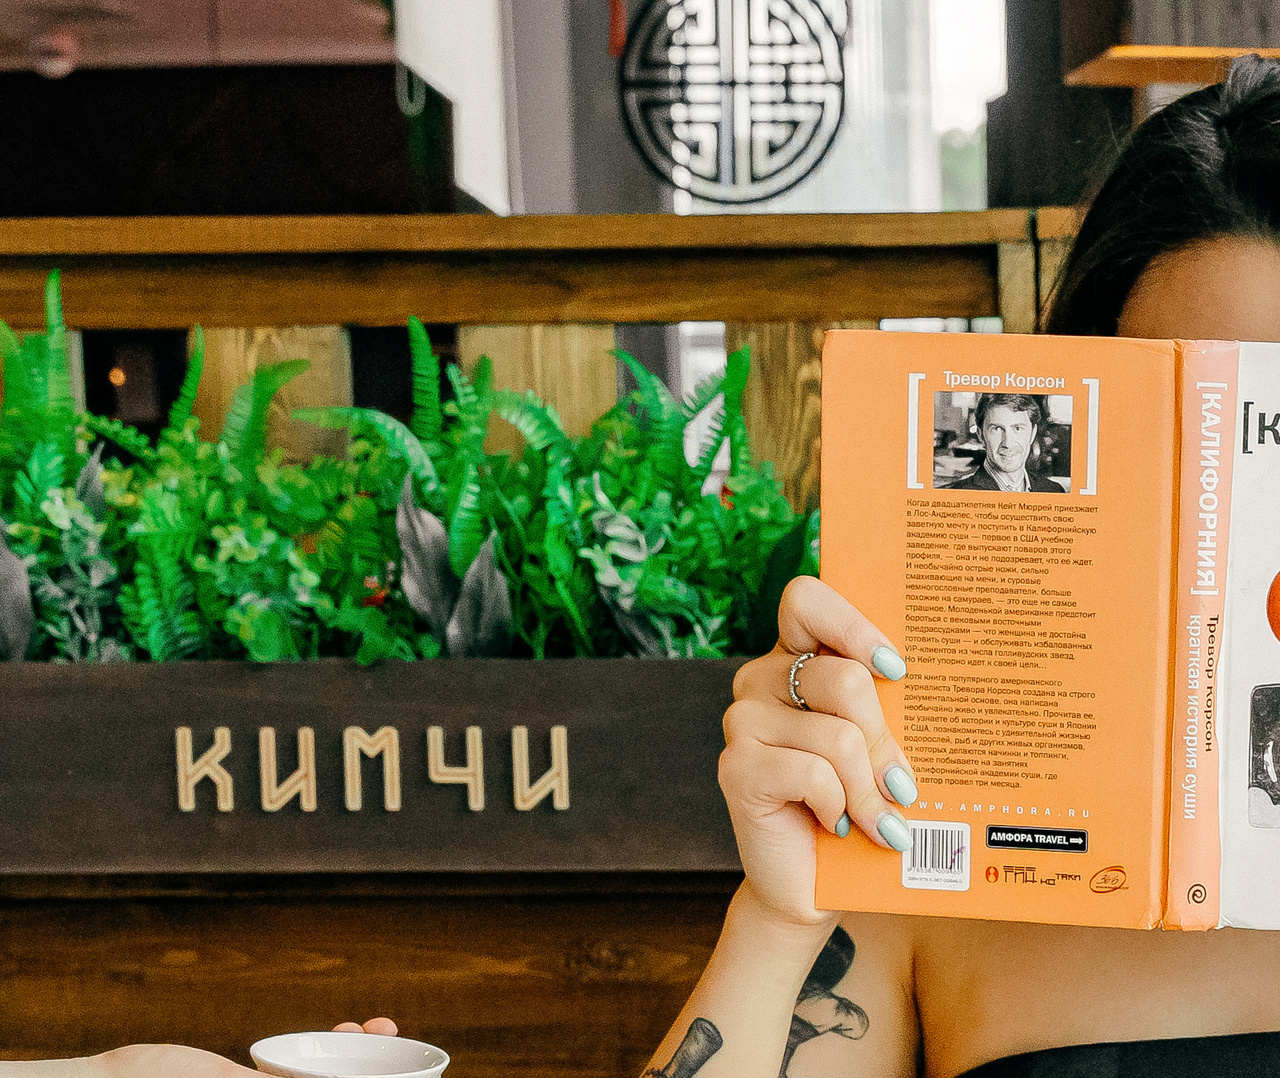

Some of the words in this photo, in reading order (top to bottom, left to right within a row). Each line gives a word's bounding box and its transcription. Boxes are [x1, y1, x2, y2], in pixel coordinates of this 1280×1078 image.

[943, 371, 1001, 388] Тревор
[1005, 373, 1065, 390] Корсон
[906, 498, 930, 508] Когда
[931, 500, 996, 510] двадцатилетняя
[998, 501, 1016, 510] Кейт
[1018, 502, 1052, 512] Мюррей
[1054, 505, 1098, 514] приезжает
[974, 511, 999, 520] чтобы
[1000, 514, 1051, 523] осуществить
[906, 520, 944, 529] заветную
[946, 522, 970, 530] мечту
[977, 523, 1017, 532] поступить
[1026, 523, 1097, 535] Калифорнийскую
[906, 532, 948, 540] академию
[949, 533, 969, 541] суши
[982, 534, 1011, 543] первое
[1020, 534, 1039, 543] США
[1040, 535, 1074, 545] учебное
[968, 544, 1012, 553] выпускают
[1013, 546, 1048, 555] поваров
[913, 562, 964, 571] необычайно
[964, 565, 994, 574] острые
[905, 573, 962, 583] смахивающие
[1007, 577, 1042, 586] суровые
[905, 583, 974, 592] немногословные
[1040, 587, 1072, 596] больше
[1021, 599, 1038, 607] еще
[948, 604, 1002, 616] Молоденькой
[1004, 608, 1054, 618] американке
[1055, 611, 1096, 620] предстоит
[905, 613, 942, 624] бороться
[992, 619, 1042, 627] восточными
[905, 625, 971, 635] предрассудками
[998, 629, 1036, 638] женщина
[1048, 630, 1086, 641] достойна
[941, 637, 961, 645] суши
[980, 637, 1032, 648] обслуживать
[1034, 640, 1093, 650] избалованных
[1205, 614, 1219, 679] Тревор
[904, 644, 957, 654] VIP-клиентов
[994, 650, 1048, 660] голливудских
[1186, 614, 1201, 689] краткая
[905, 654, 916, 662] Но
[917, 655, 936, 663] Кейт
[937, 657, 966, 666] упорно
[967, 659, 985, 667] идет
[993, 658, 1018, 667] своей
[904, 672, 922, 680] Хотя
[948, 675, 999, 685] популярного
[1000, 678, 1062, 688] американского
[904, 684, 951, 693] журналиста
[953, 684, 985, 695] Тревора
[987, 686, 1021, 697] Корсона
[1022, 689, 1056, 698] создана
[1068, 692, 1096, 700] строго
[904, 692, 969, 704] документальной
[1020, 699, 1059, 707] написана
[904, 703, 953, 713] необычайно
[1043, 709, 1082, 720] Прочитав
[916, 715, 948, 724] узнаете
[949, 715, 960, 723] об
[961, 717, 994, 726] истории
[1002, 719, 1036, 728] культуре
[1038, 721, 1058, 729] суши
[1066, 721, 1097, 730] Японии
[933, 726, 994, 735] познакомитесь
[1002, 728, 1057, 740] удивительной
[1184, 695, 1199, 769] история
[954, 736, 971, 746] рыб
[978, 739, 1005, 748] других
[175, 725, 569, 812] КИМЧИ
[1182, 772, 1197, 819] суши
[990, 832, 1032, 844] АМФОРА
[1034, 834, 1069, 845] TRAVEL
